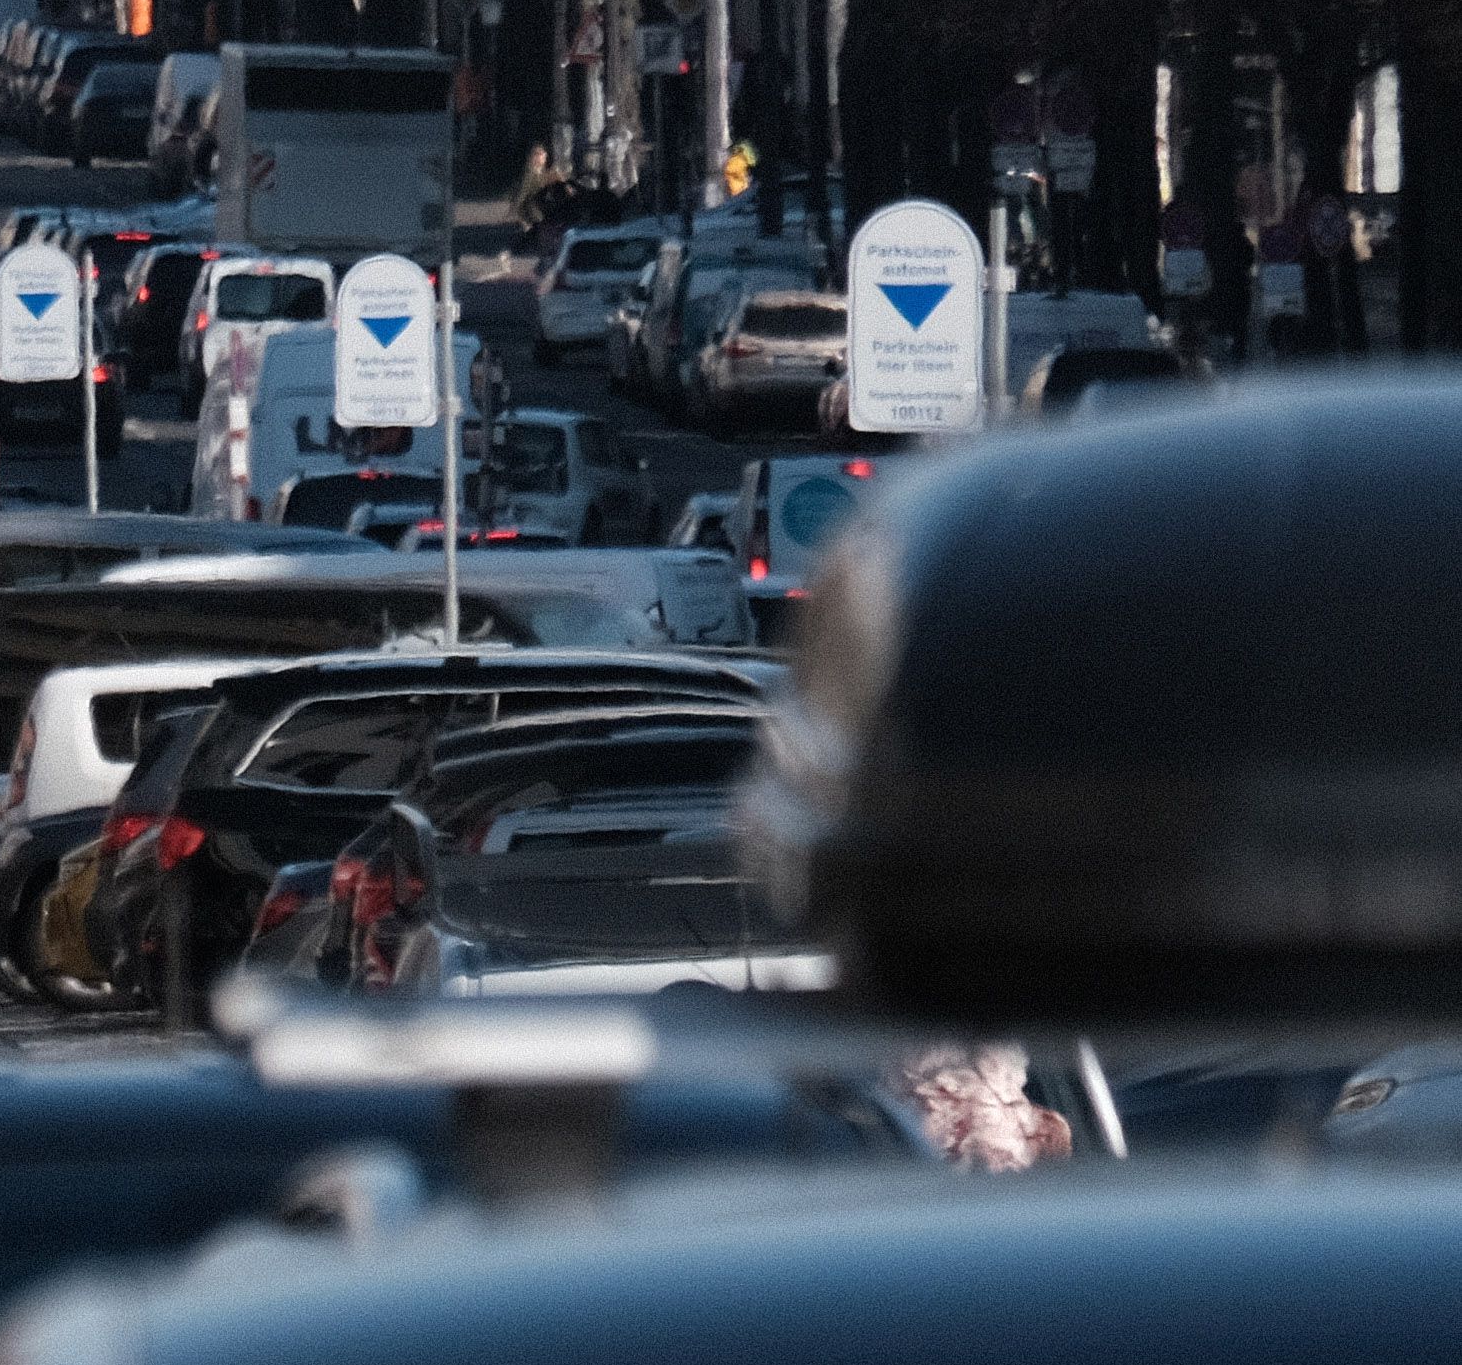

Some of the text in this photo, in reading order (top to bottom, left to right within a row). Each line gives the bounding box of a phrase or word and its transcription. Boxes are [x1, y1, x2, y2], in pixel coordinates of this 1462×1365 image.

[866, 244, 962, 259] Parkschein-
[882, 263, 949, 277] automat
[872, 339, 959, 354] Parkschein
[876, 361, 906, 373] hier
